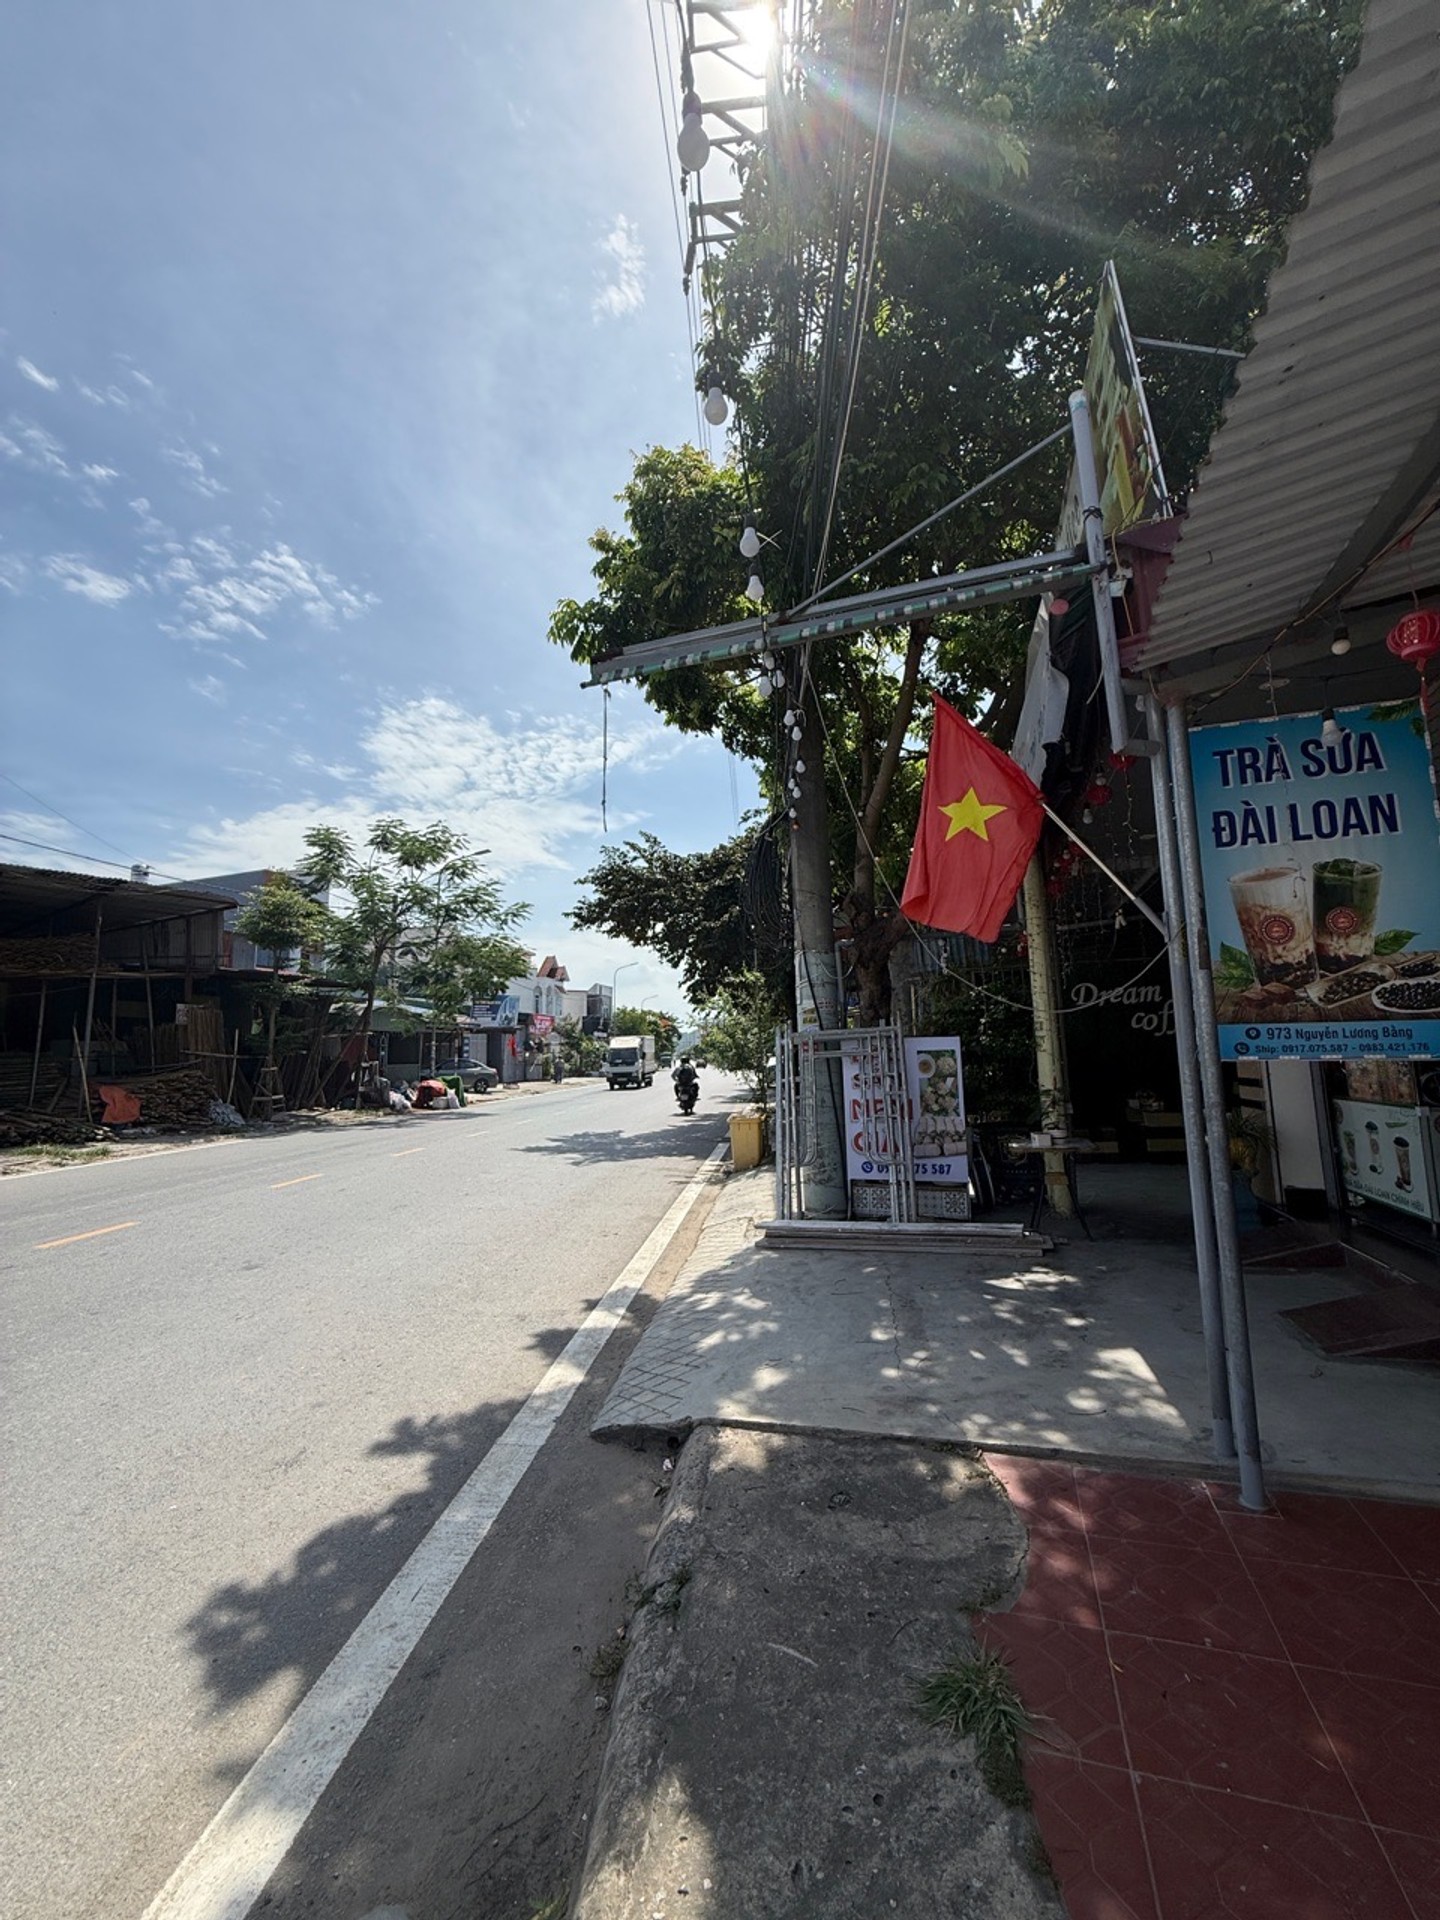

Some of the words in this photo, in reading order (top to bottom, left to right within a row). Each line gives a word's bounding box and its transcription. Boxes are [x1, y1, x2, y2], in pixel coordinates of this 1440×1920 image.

[1212, 736, 1292, 788] TRÀ
[1212, 800, 1278, 848] ĐÀI
[1288, 793, 1400, 842] LOAN
[1071, 982, 1162, 1006] Dream
[1266, 1027, 1291, 1040] 973
[1295, 1026, 1339, 1041] Nguyễn
[1342, 1027, 1379, 1041] Lương
[1255, 1044, 1279, 1055] Ship:
[931, 1163, 952, 1175] 587
